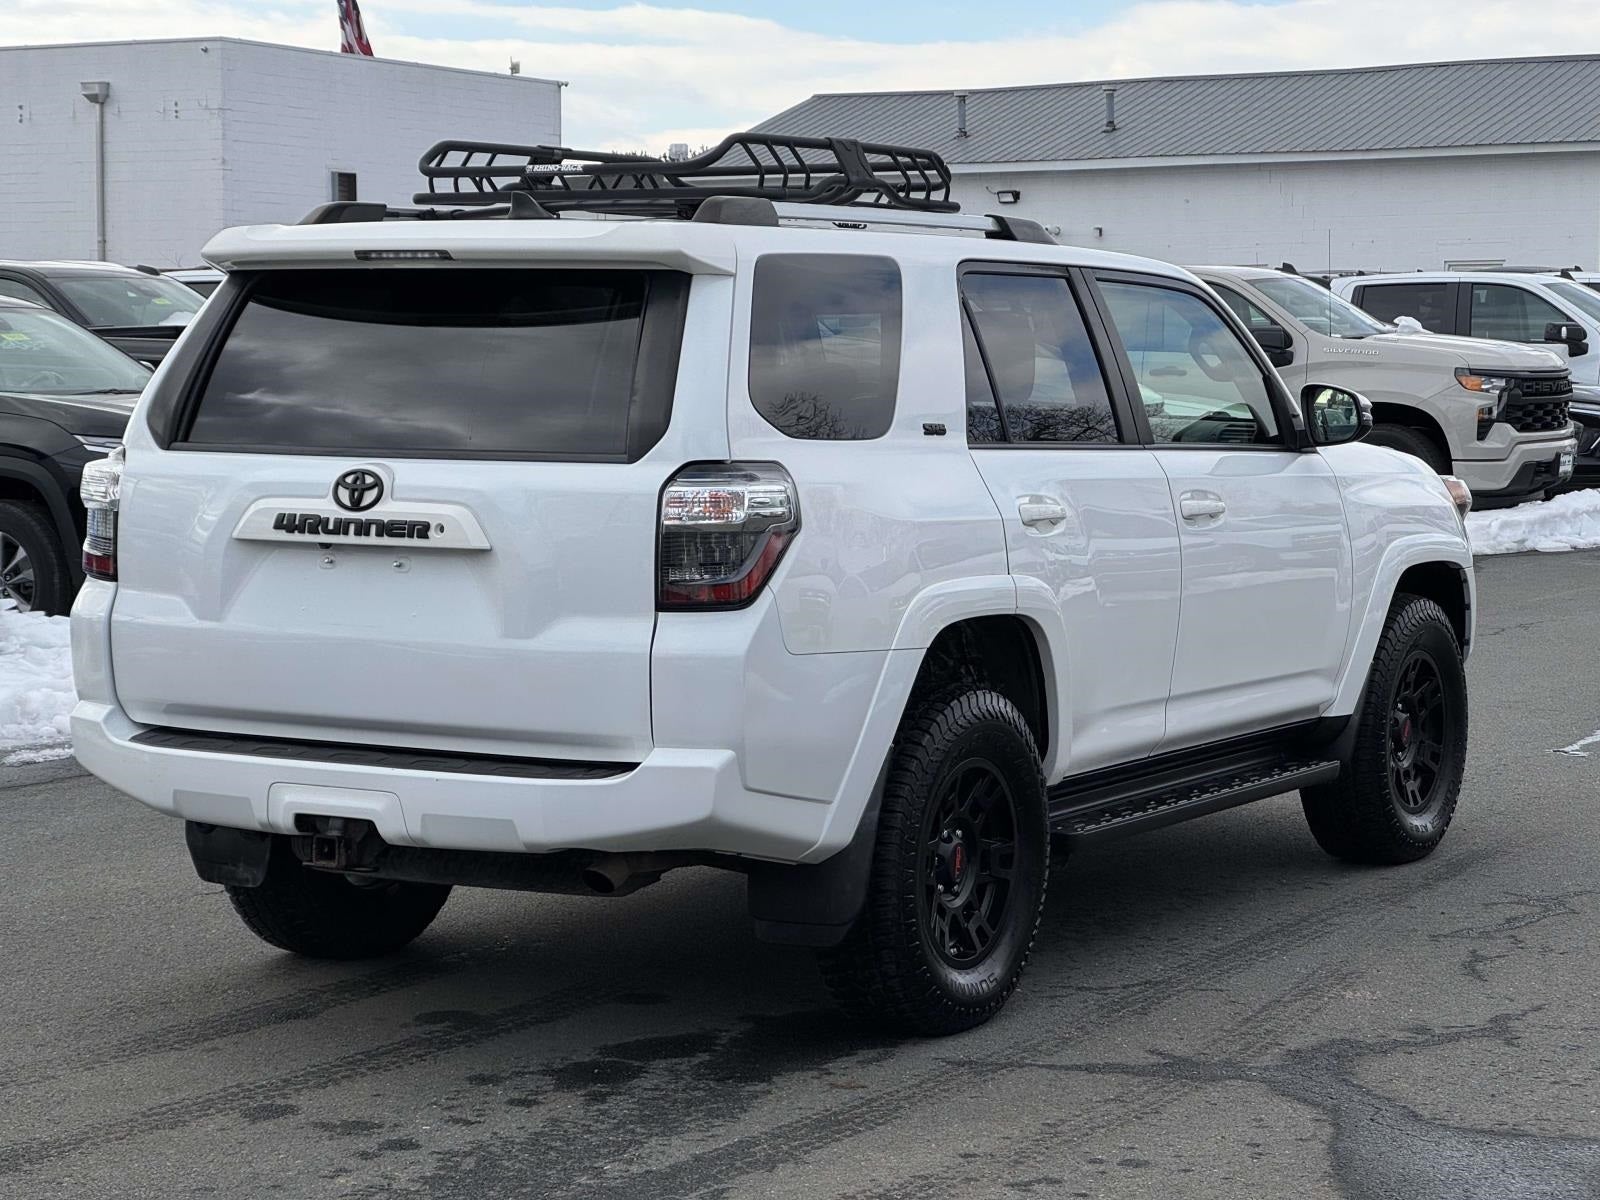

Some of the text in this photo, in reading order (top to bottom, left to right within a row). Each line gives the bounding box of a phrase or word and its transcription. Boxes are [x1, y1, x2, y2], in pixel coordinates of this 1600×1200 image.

[533, 164, 583, 172] RHINO-RACK
[1323, 347, 1380, 355] SILVERADO
[923, 423, 947, 436] SR5
